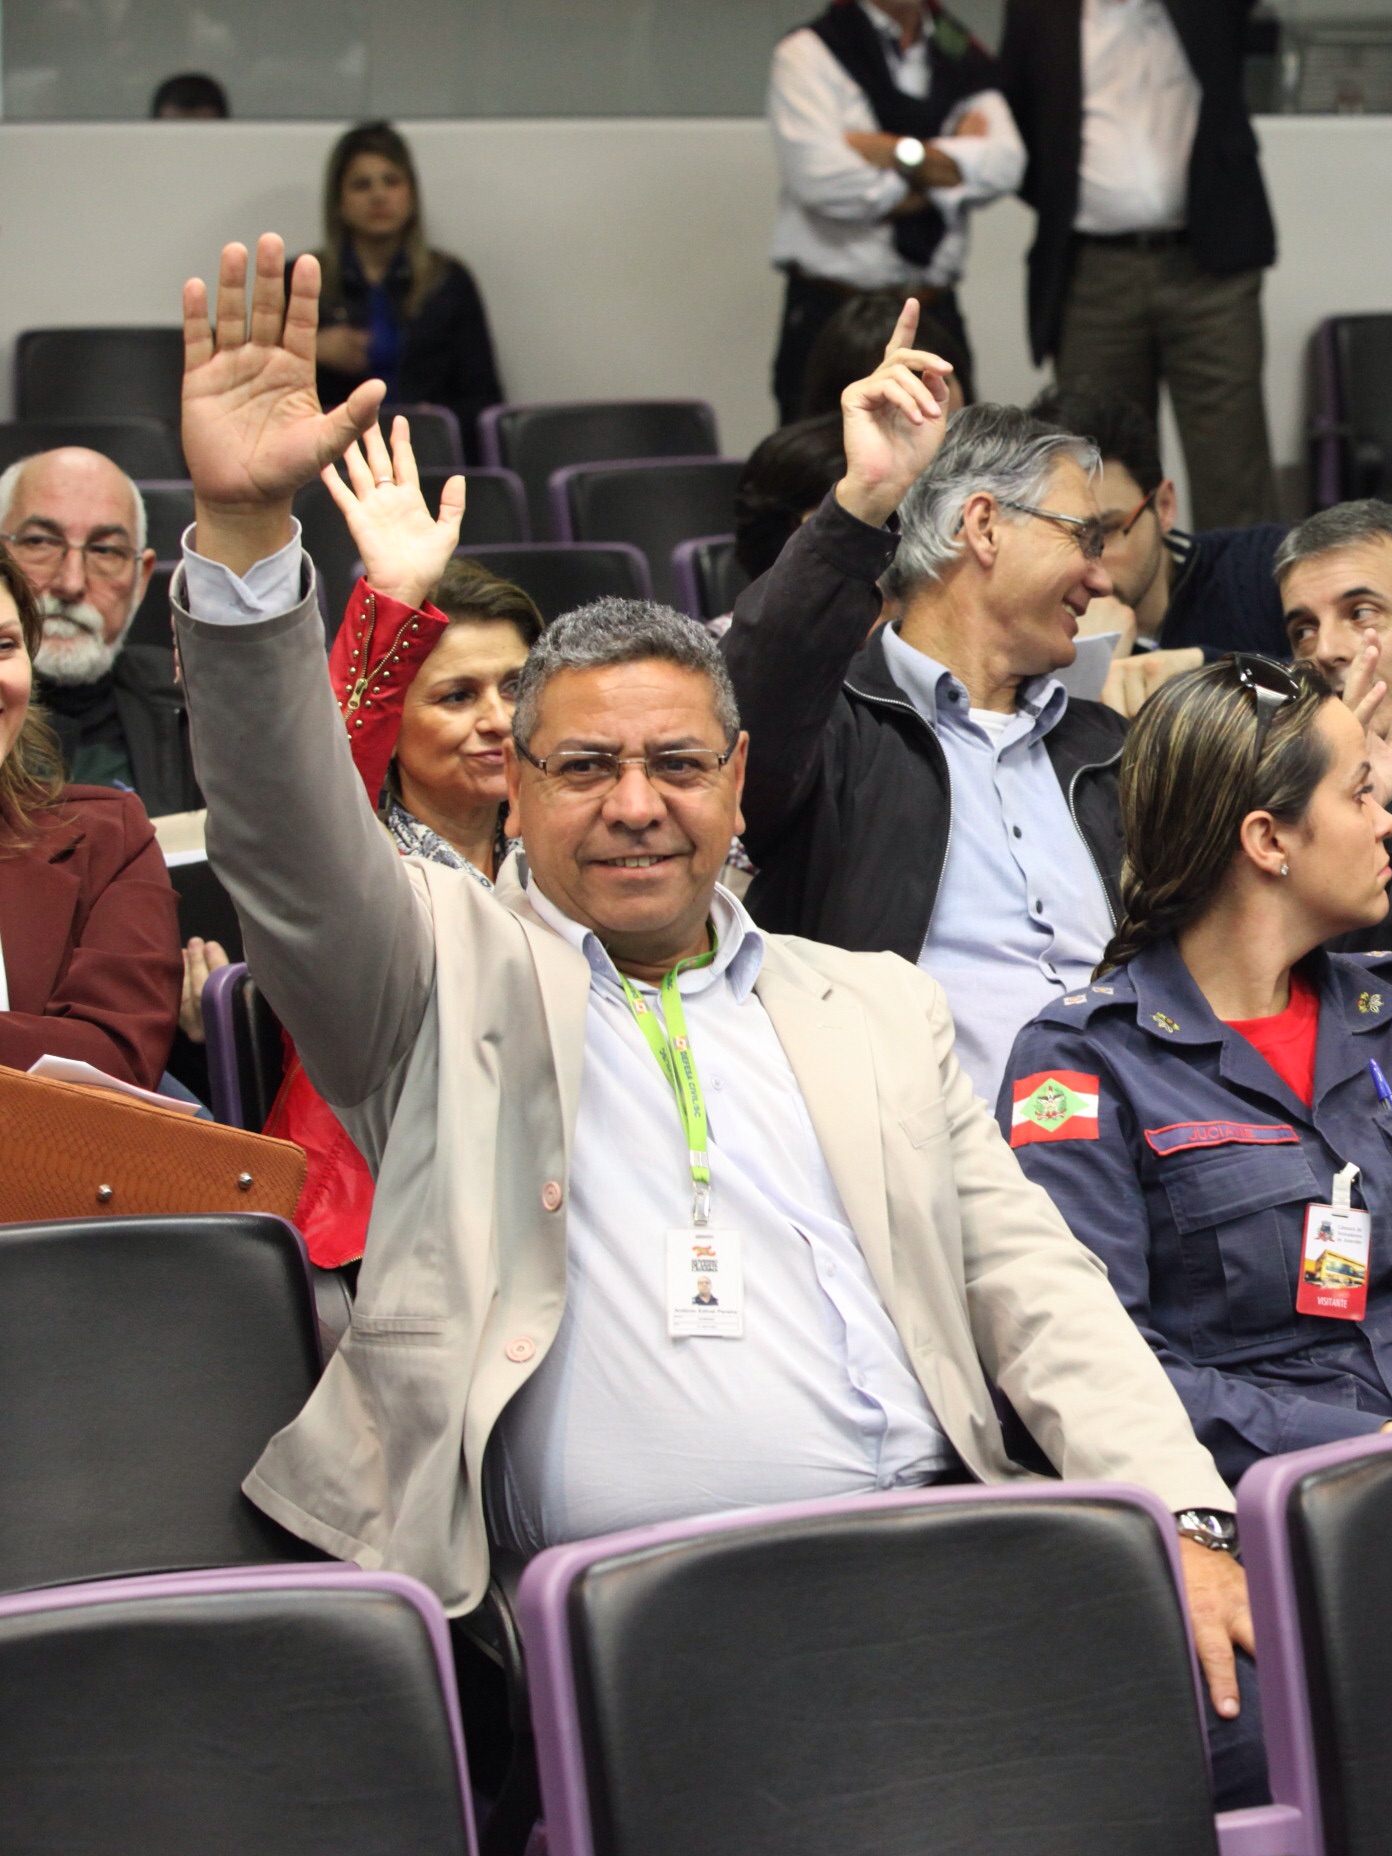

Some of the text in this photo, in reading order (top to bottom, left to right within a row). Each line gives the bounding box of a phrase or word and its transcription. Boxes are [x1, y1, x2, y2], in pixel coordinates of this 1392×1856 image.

[680, 1050, 692, 1080] DEFESA
[688, 1082, 699, 1104] CIVIL
[1317, 1296, 1348, 1309] VISITANTE
